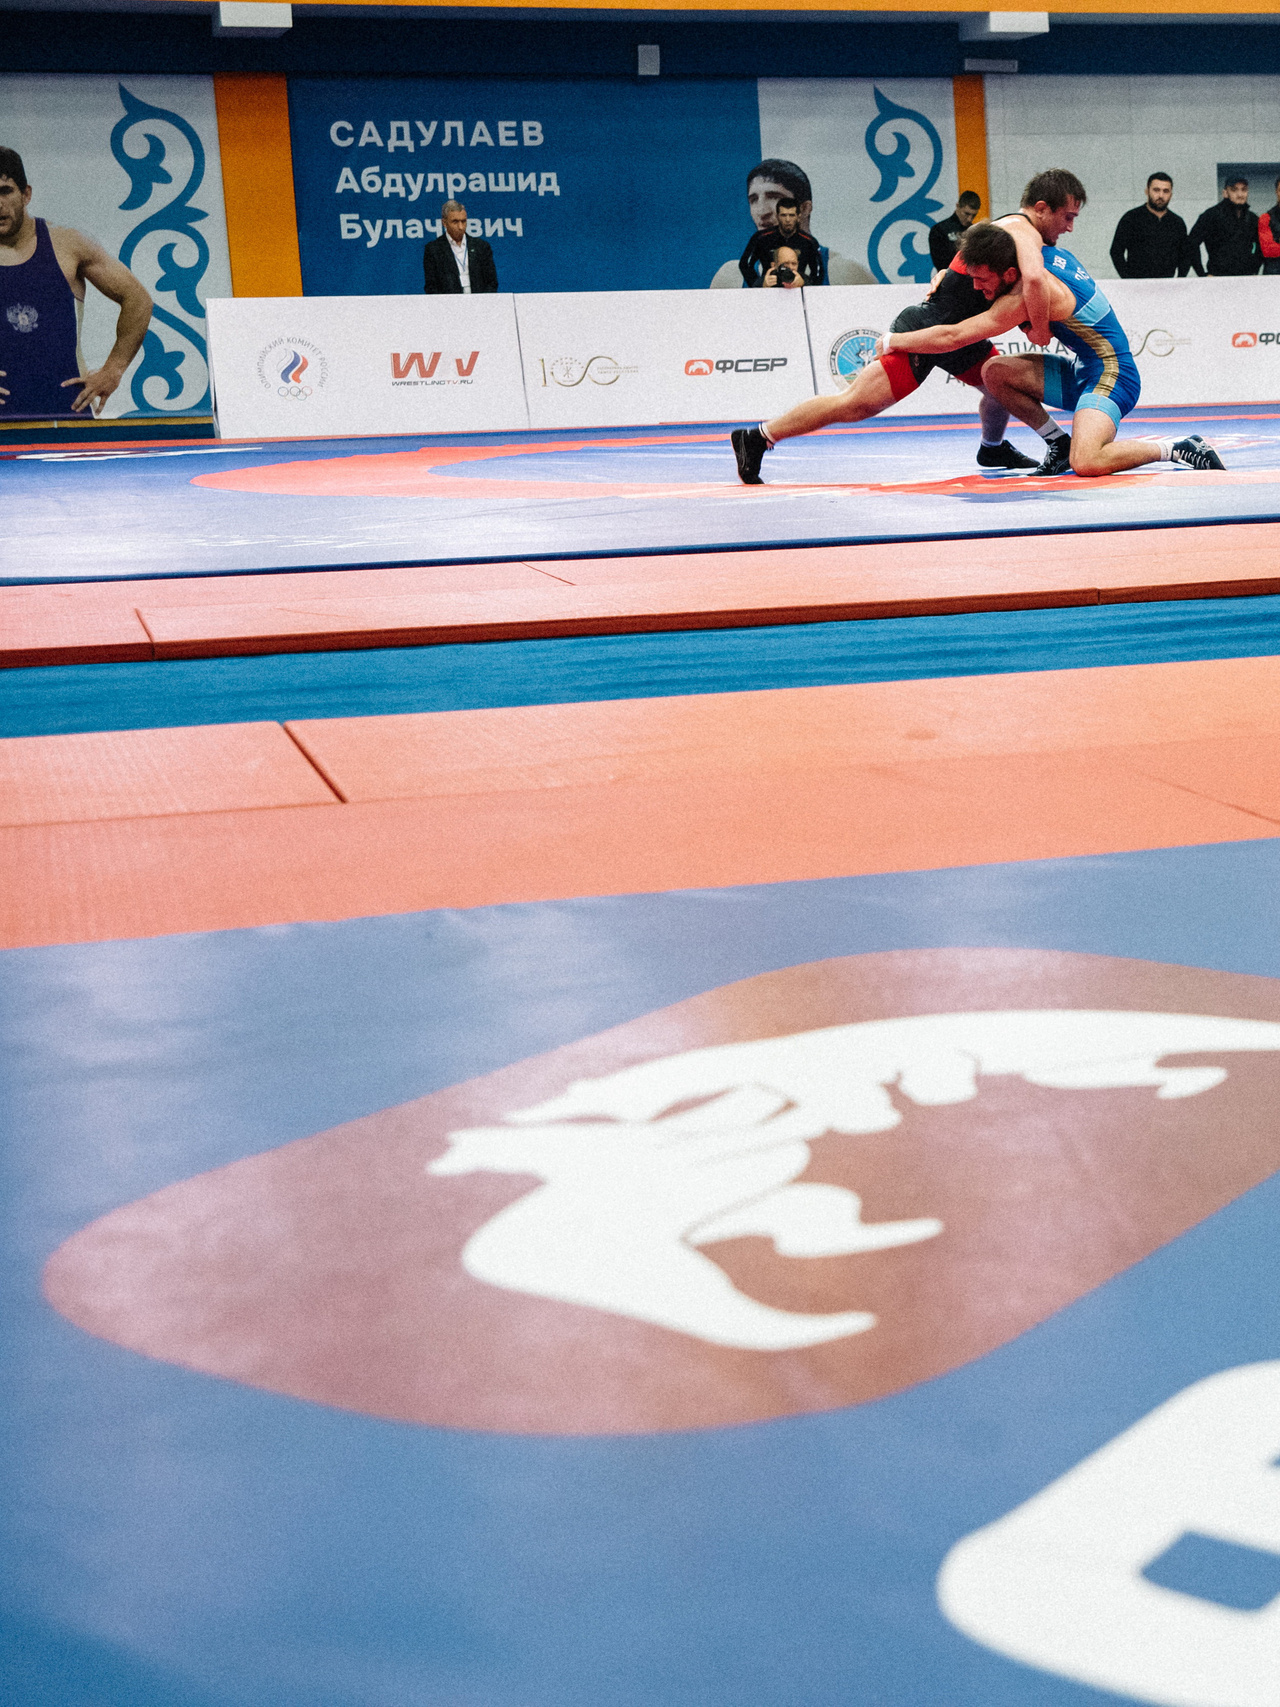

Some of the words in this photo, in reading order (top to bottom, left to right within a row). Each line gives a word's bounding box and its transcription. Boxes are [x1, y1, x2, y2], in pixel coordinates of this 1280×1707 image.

[330, 120, 545, 152] САДУЛАЕВ
[335, 165, 561, 202] Абдулрашид
[339, 213, 524, 248] Булачвич
[287, 336, 322, 356] КОМИТЕТ
[318, 357, 329, 388] РОССИИ
[715, 357, 788, 374] ФСБР
[391, 379, 474, 387] WRESTLINGTV.RU
